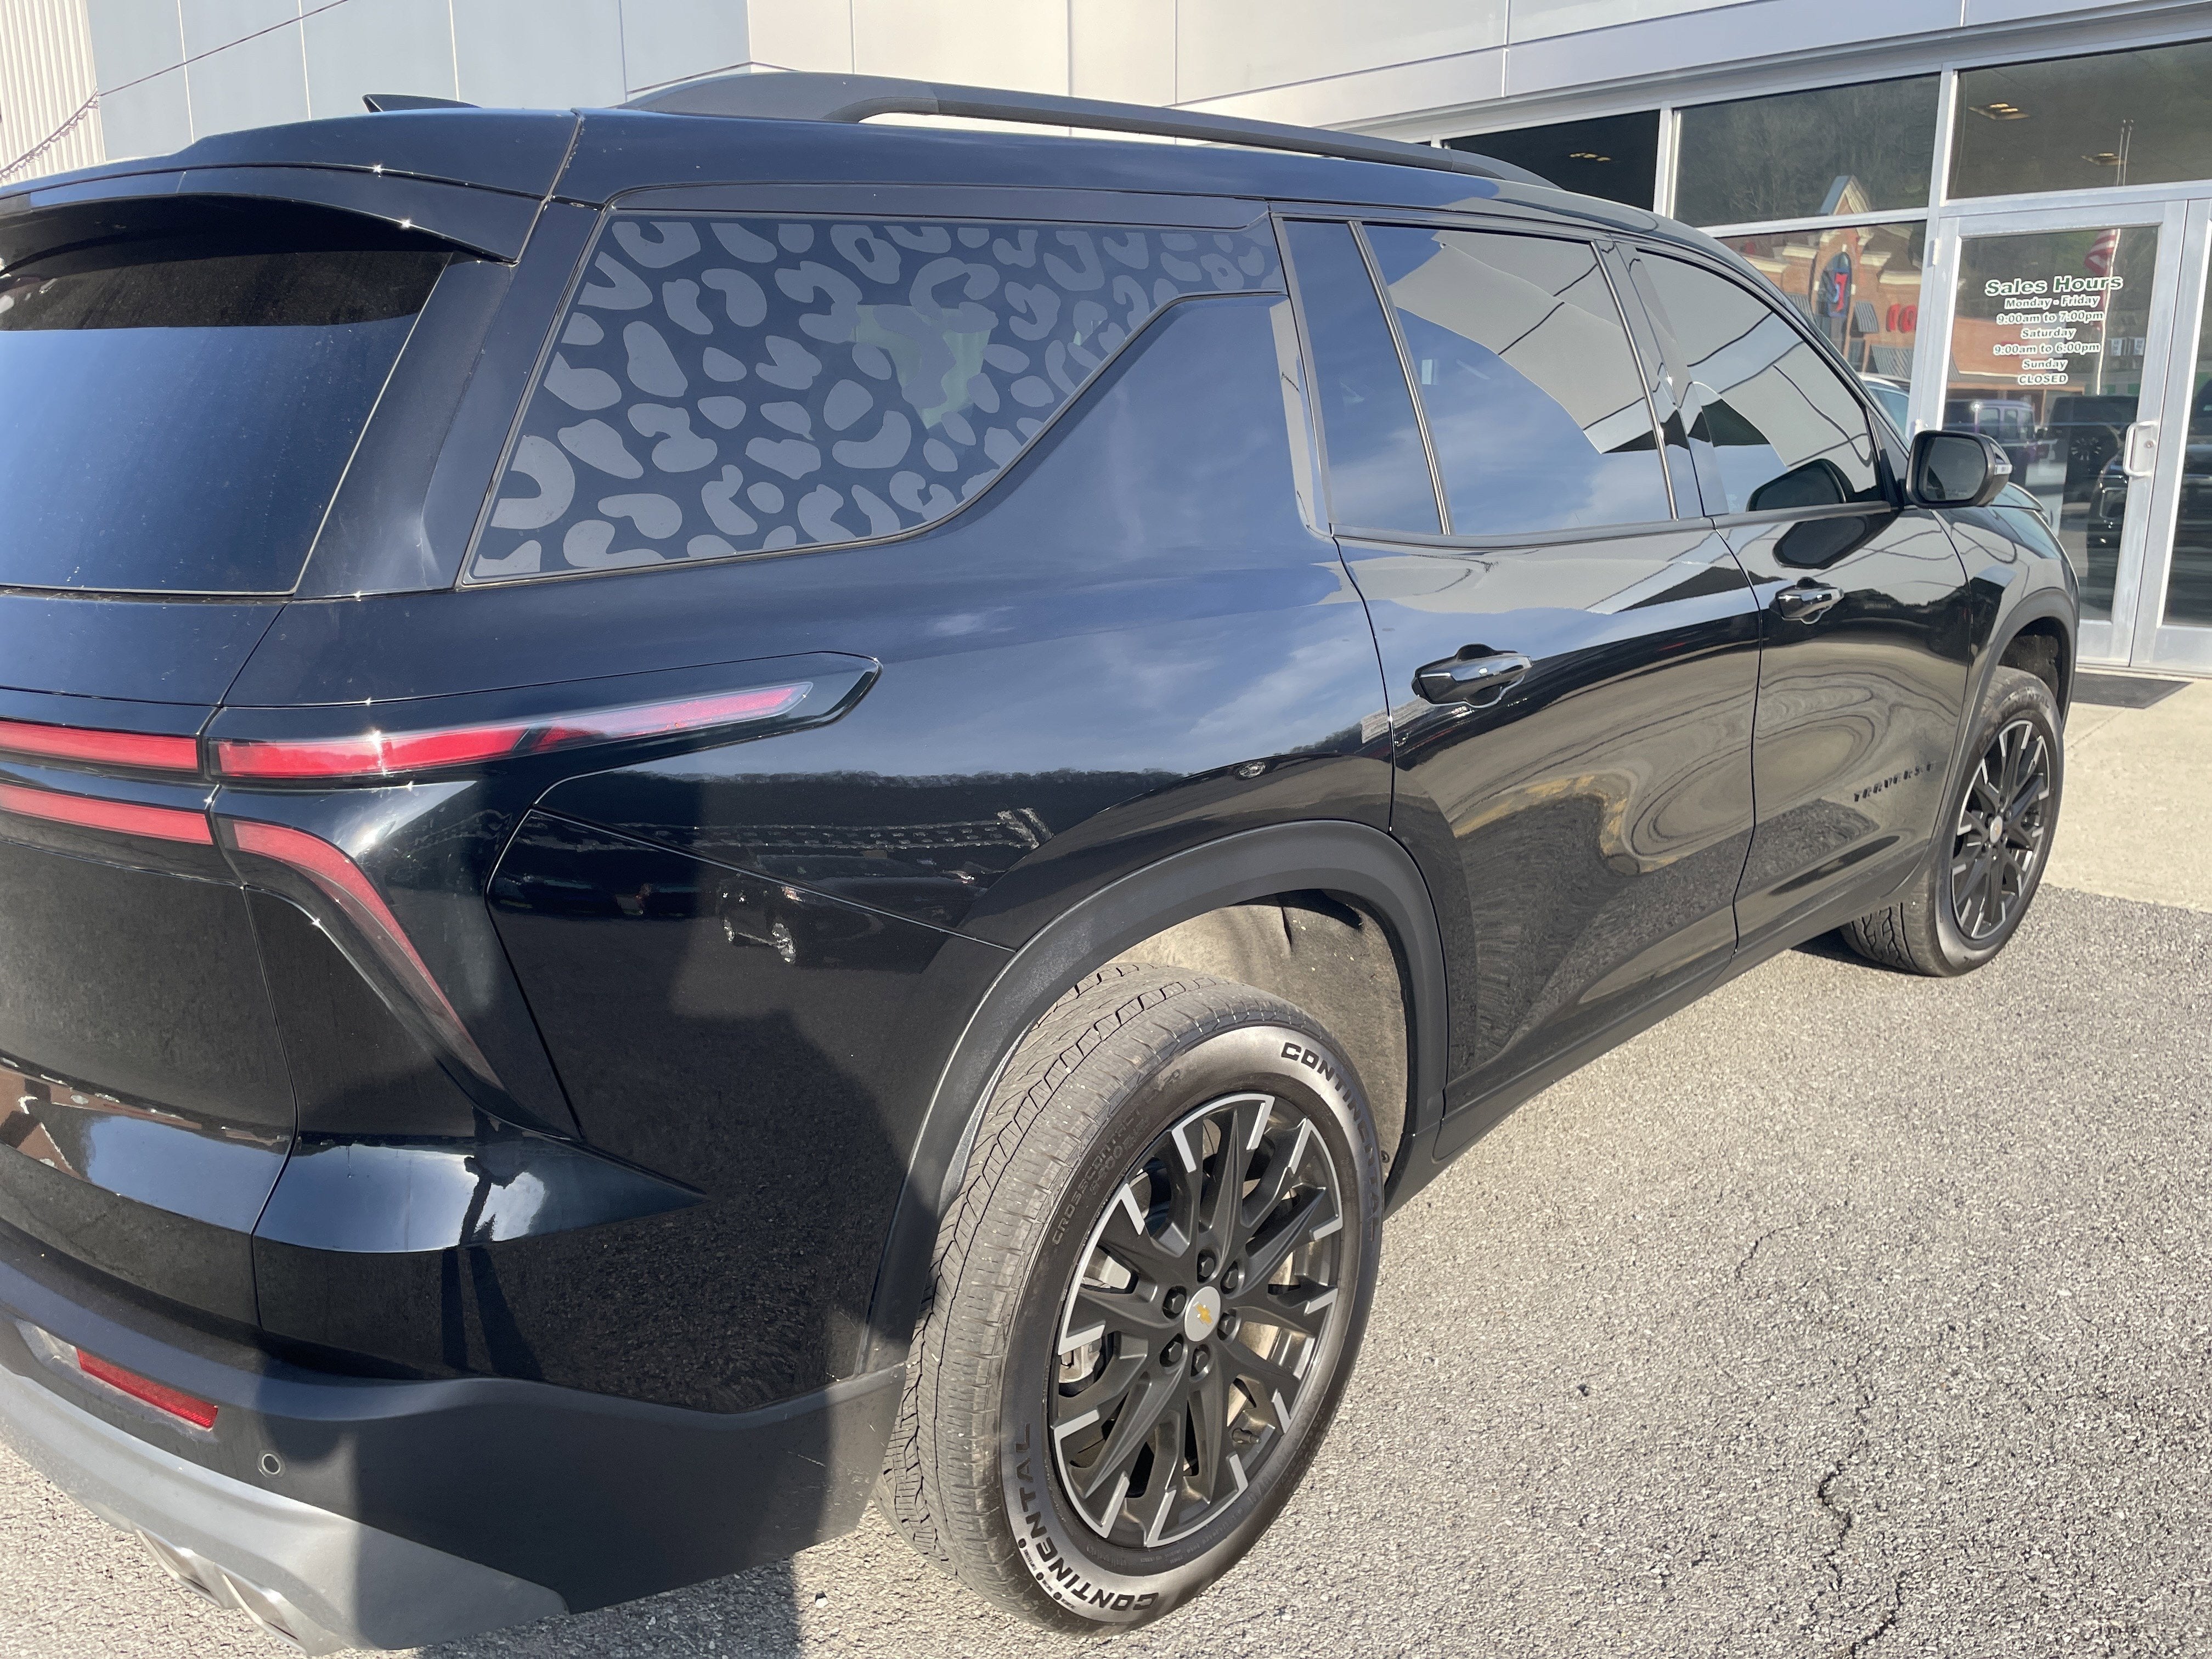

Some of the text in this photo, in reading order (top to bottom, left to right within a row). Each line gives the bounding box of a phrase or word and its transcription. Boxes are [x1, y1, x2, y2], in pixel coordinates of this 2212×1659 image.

[1985, 275, 2123, 296] Sales Hours
[2004, 296, 2052, 309] Monday
[2061, 295, 2100, 307] Friday
[1996, 310, 2104, 325] 9:00am to 7:00pm
[2021, 327, 2076, 340] Saturday
[1993, 343, 2038, 356] 9:00am
[2039, 343, 2053, 354] to
[2055, 341, 2101, 355] 6:00pm
[2022, 358, 2068, 371] Sunday
[2018, 373, 2068, 385] CLOSED
[1281, 1042, 1380, 1242] CONTINENTAL
[1015, 1423, 1159, 1611] CONTINENTAL
